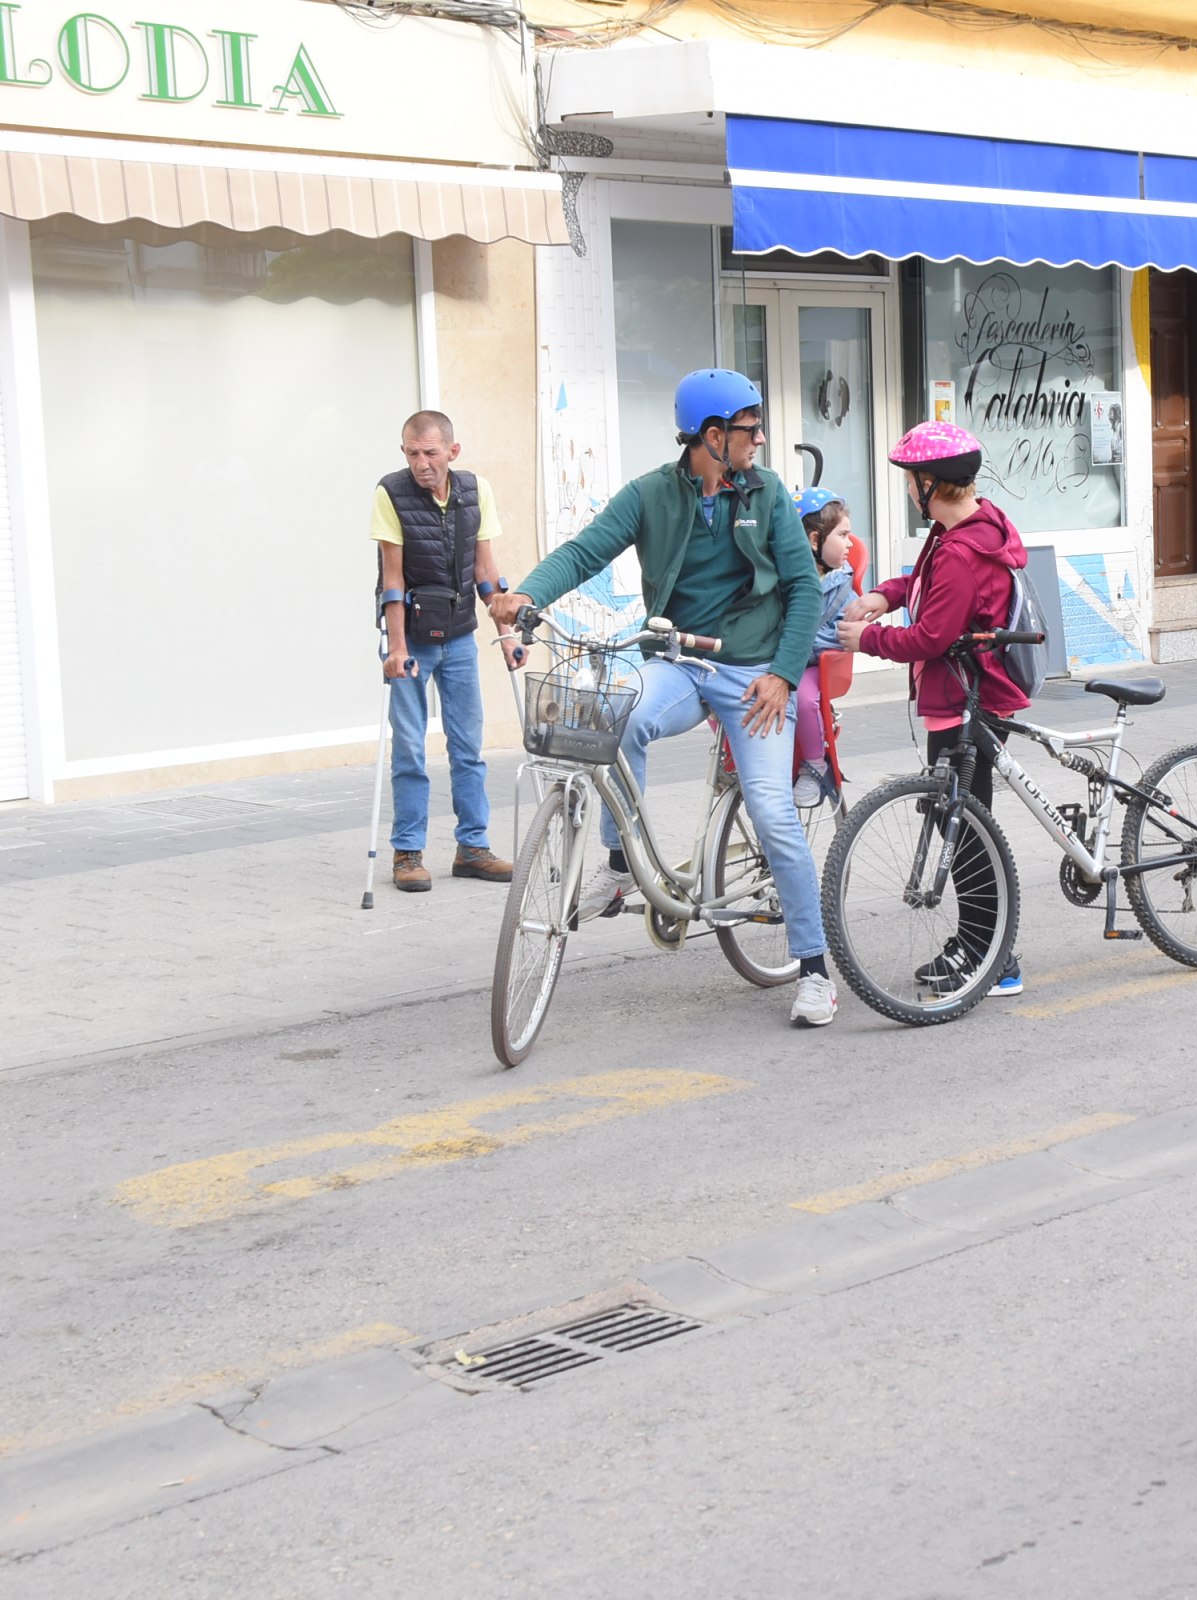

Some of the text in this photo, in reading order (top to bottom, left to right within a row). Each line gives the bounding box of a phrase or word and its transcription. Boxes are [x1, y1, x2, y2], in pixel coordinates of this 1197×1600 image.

[964, 347, 1087, 432] Calabria
[1003, 437, 1055, 480] 1916
[1018, 772, 1077, 846] TOPBIKE
